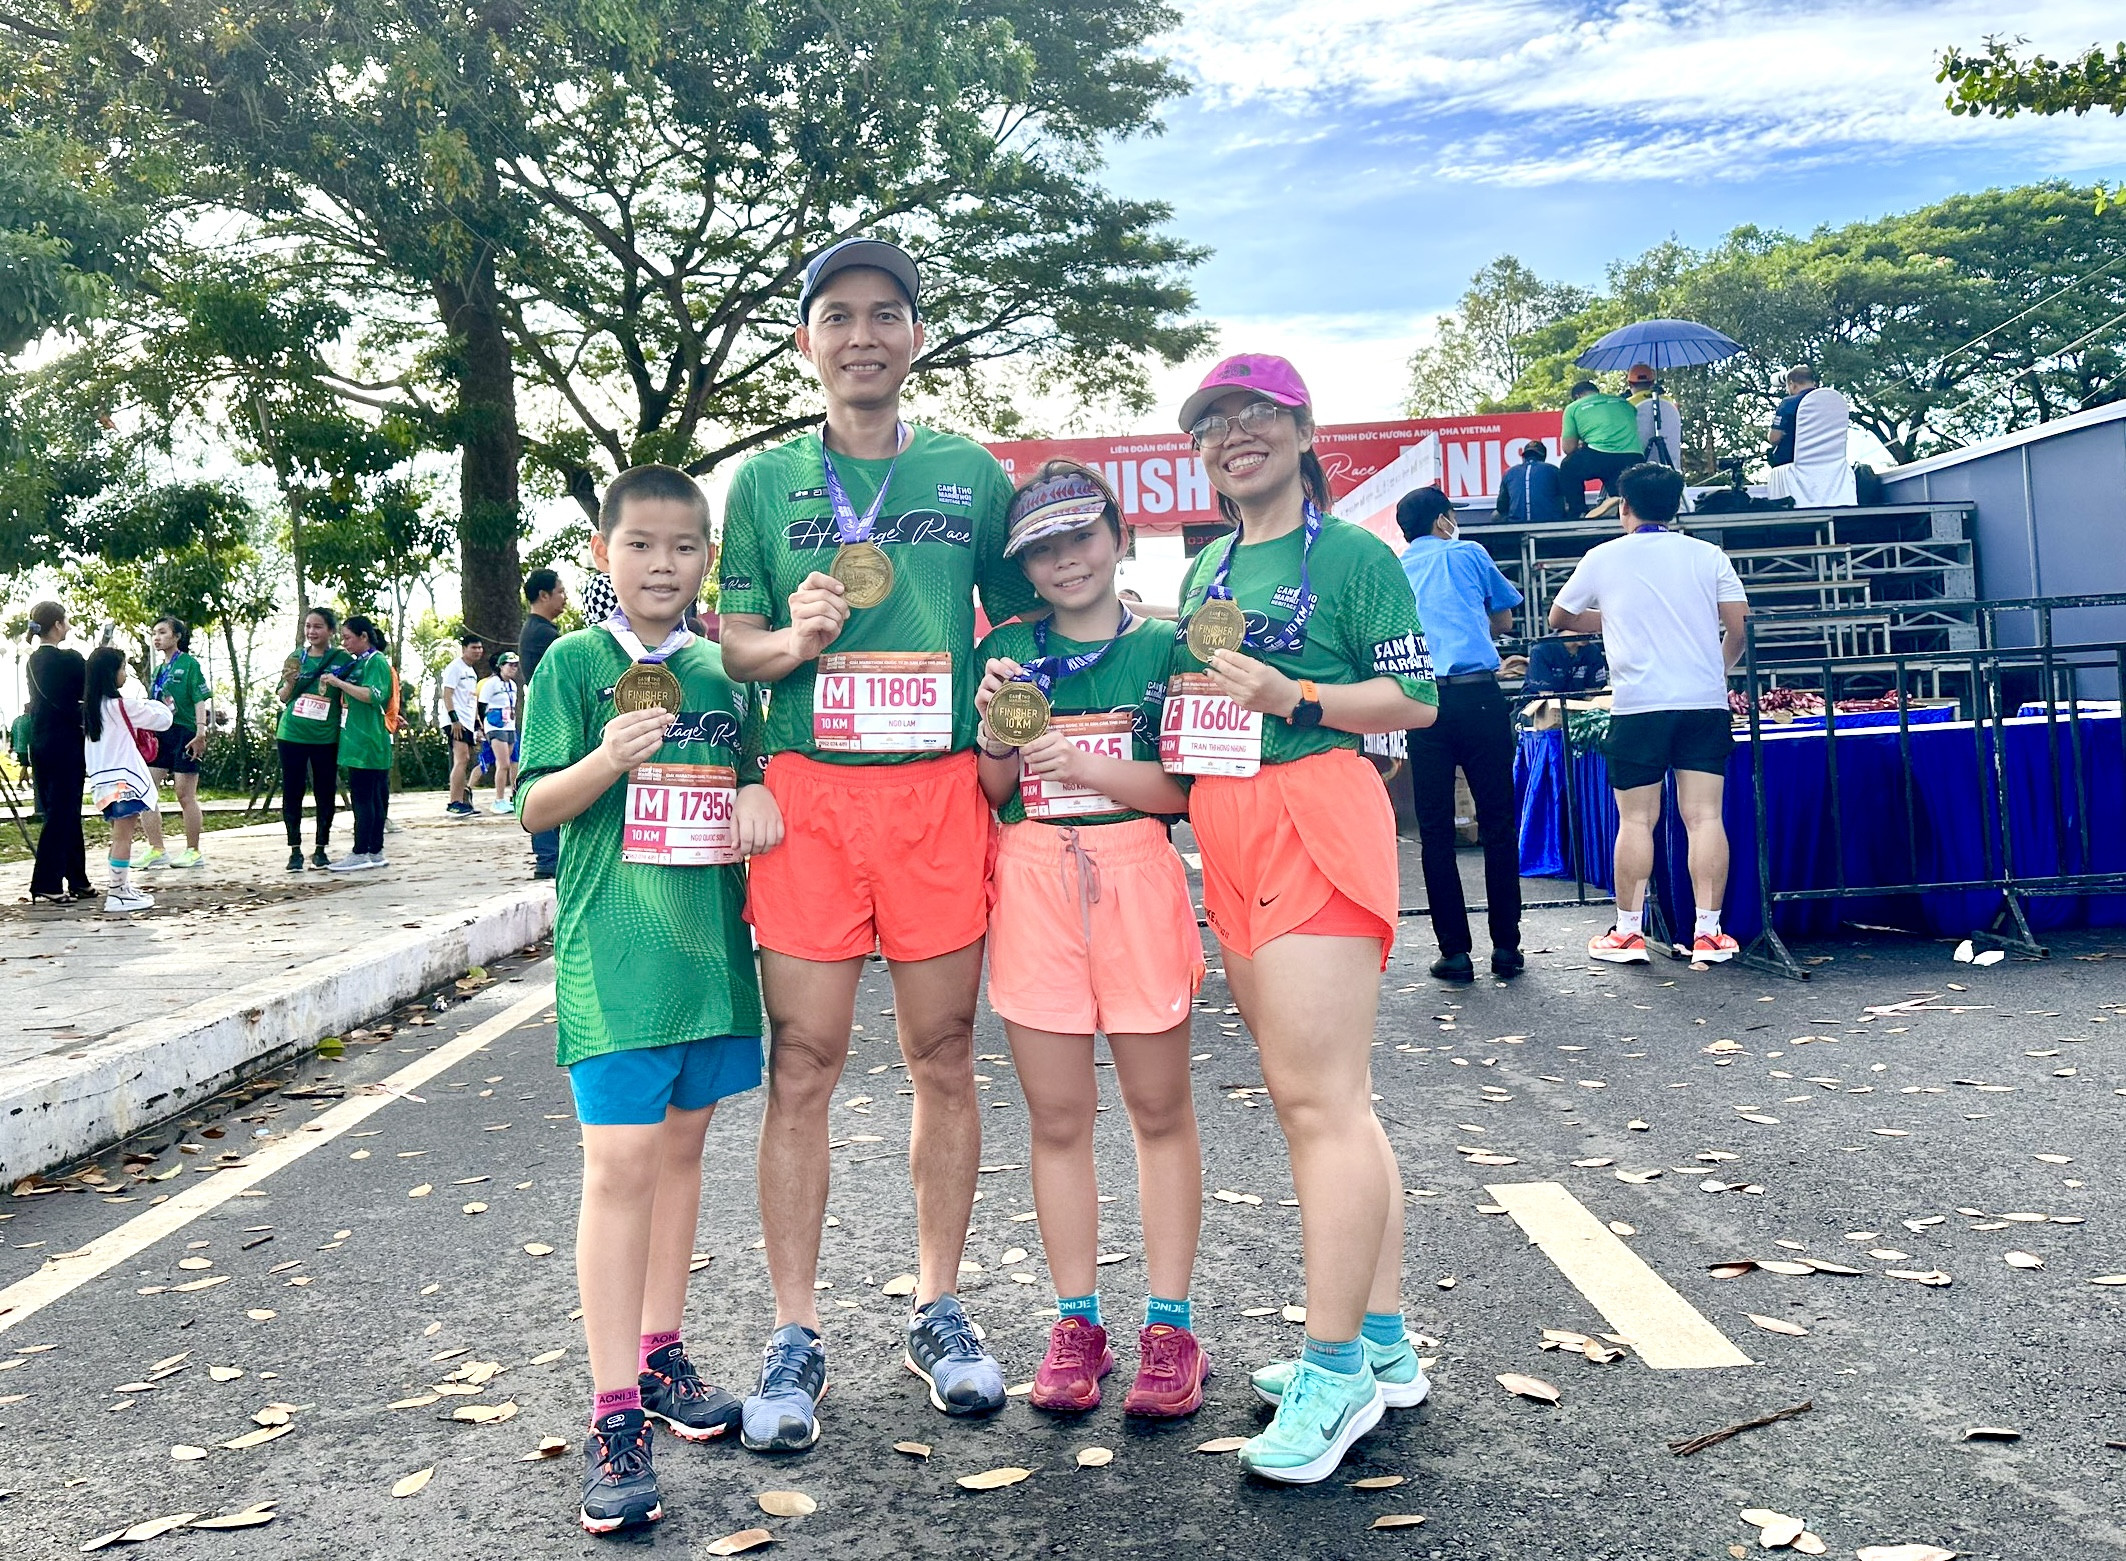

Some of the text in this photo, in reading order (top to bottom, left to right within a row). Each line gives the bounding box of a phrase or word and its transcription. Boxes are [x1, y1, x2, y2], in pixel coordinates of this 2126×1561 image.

[1333, 433, 1357, 442] TNHH
[1440, 426, 1460, 436] DHA
[1462, 424, 1501, 435] VIETNAM
[1318, 452, 1379, 483] Race
[896, 508, 972, 547] Race
[1284, 604, 1309, 636] 10 KM
[1199, 624, 1234, 636] FINISHER
[1202, 634, 1227, 646] 10 KM
[627, 690, 669, 701] FINISHER
[826, 677, 938, 707] M 11805
[634, 701, 662, 711] 10 KM
[999, 707, 1038, 719] FINISHER
[1192, 699, 1252, 731] 16602
[820, 717, 916, 730] 10 KM NGO LAM
[1005, 717, 1031, 729] 10 KM
[1191, 742, 1207, 751] TRAN
[638, 788, 734, 821] M 17356
[631, 829, 642, 841] 10
[643, 830, 660, 843] KM
[598, 1389, 639, 1405] AONIJIE
